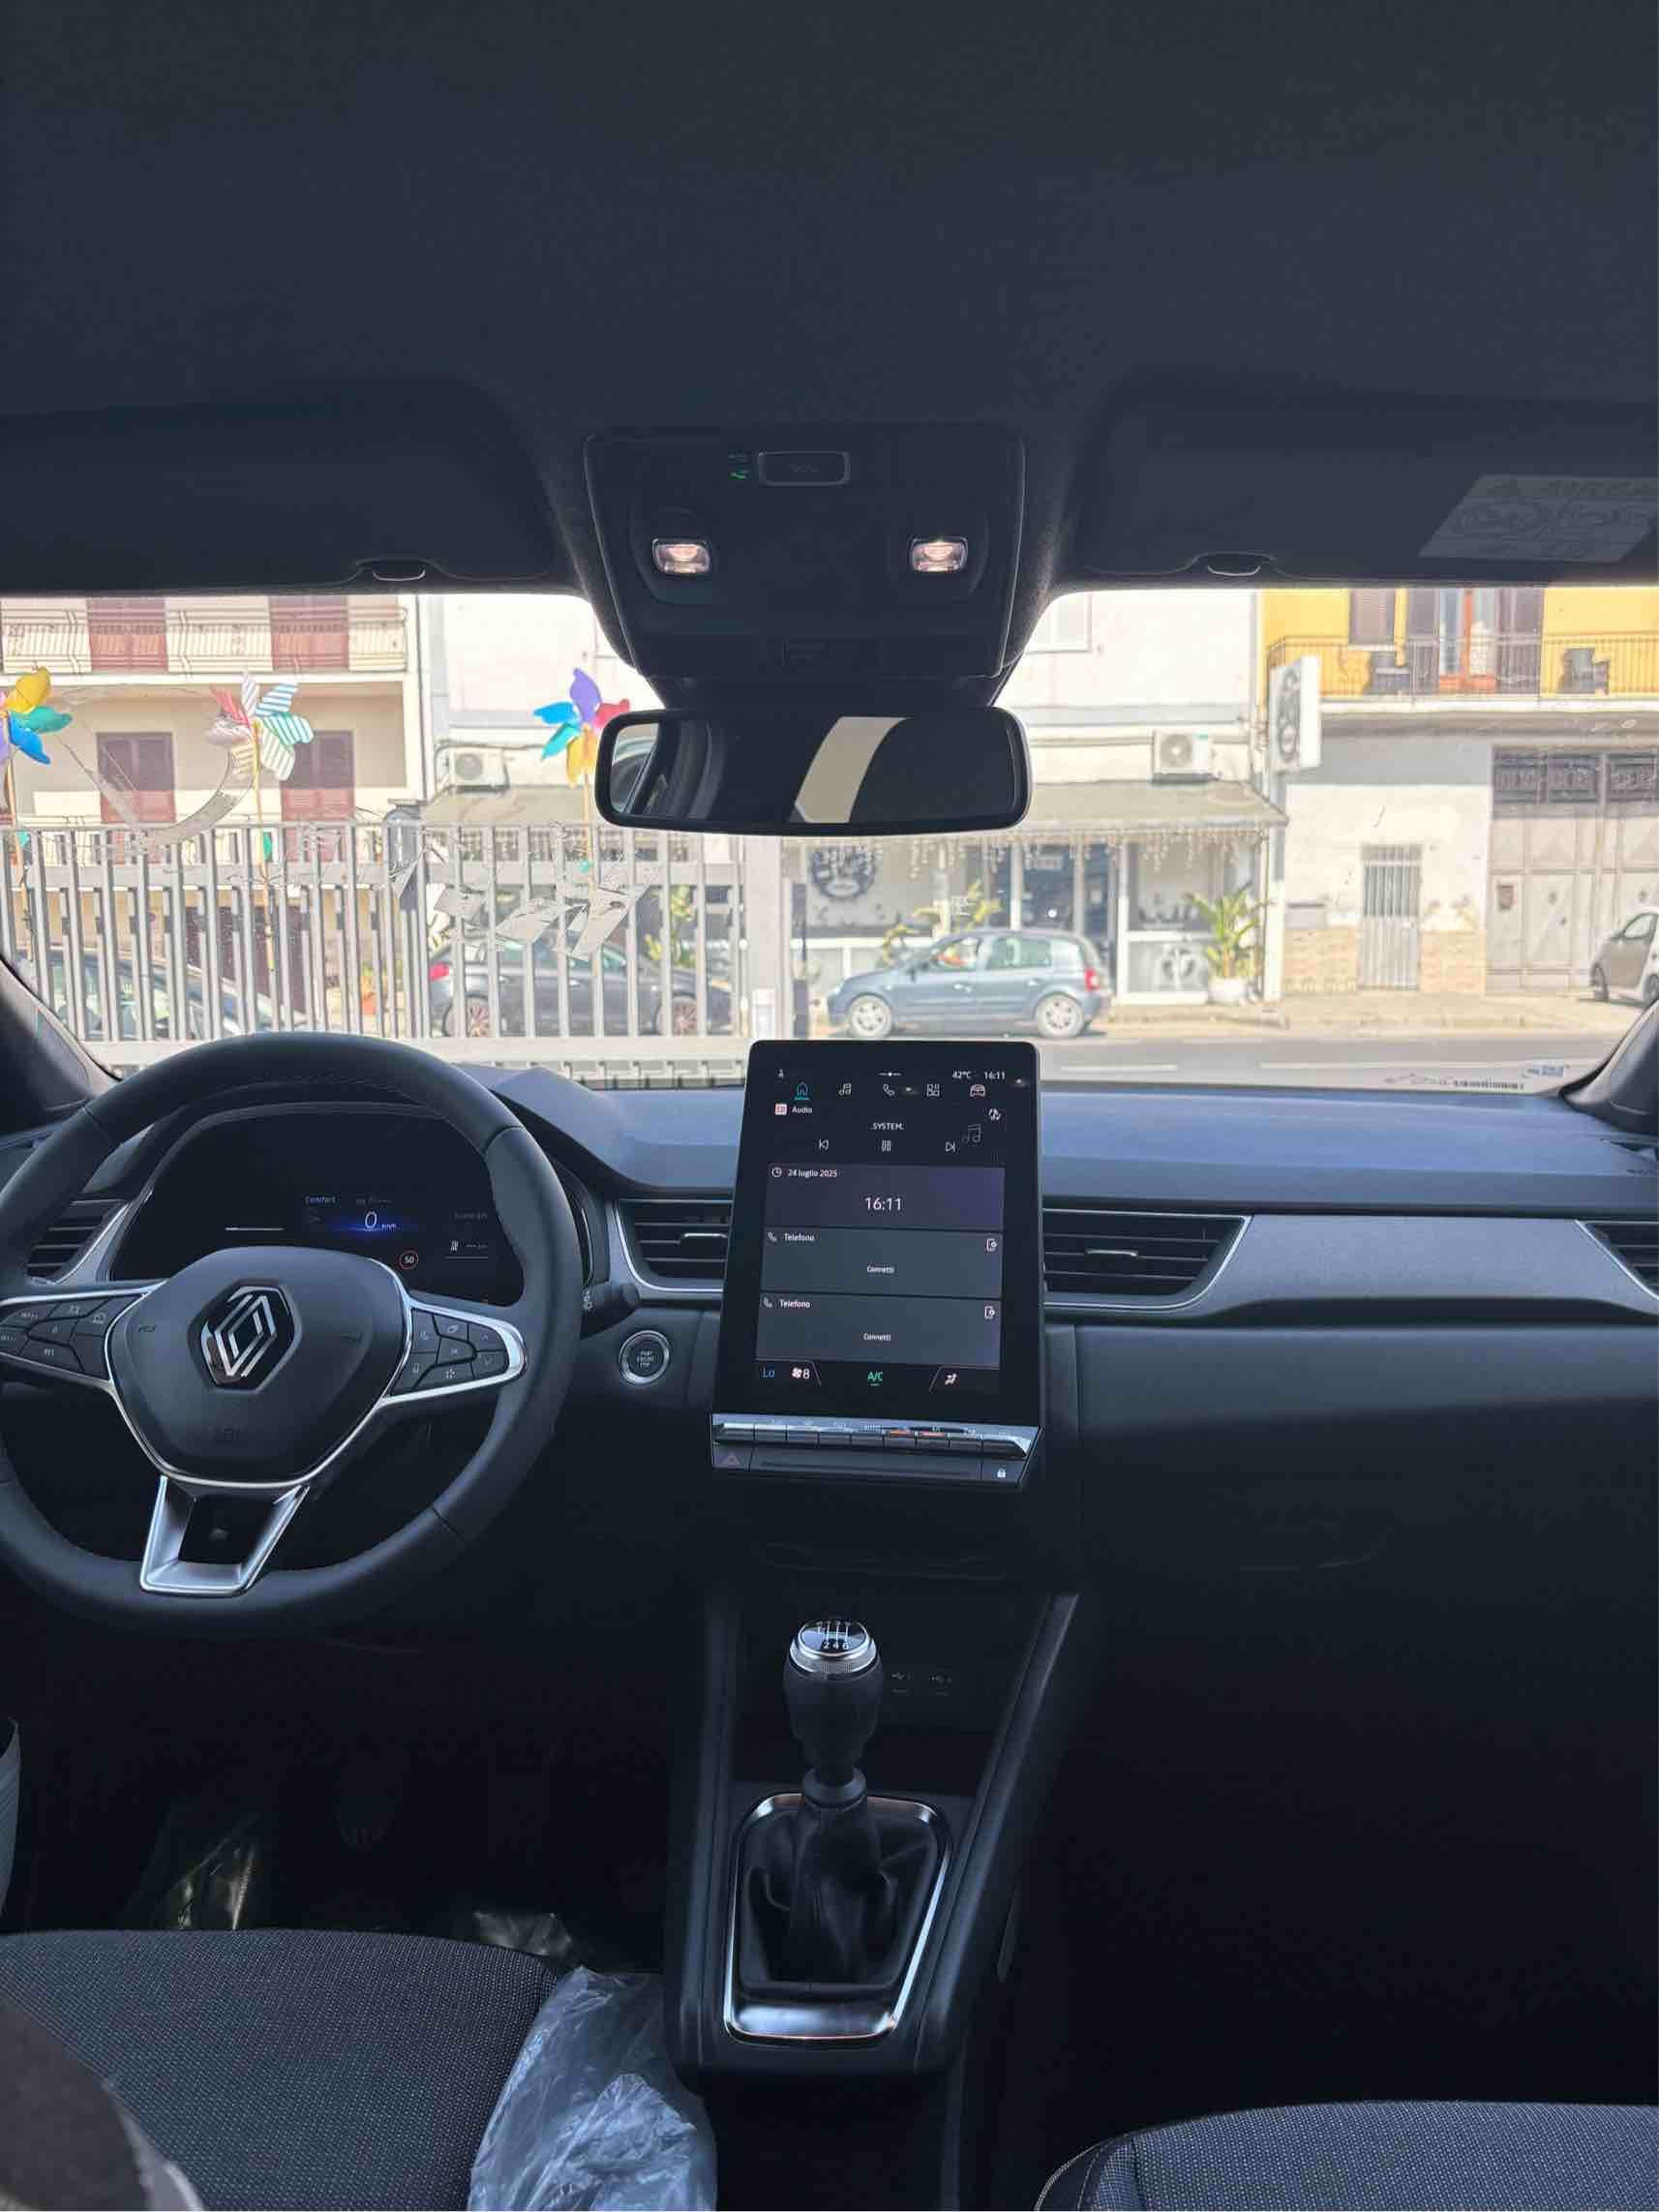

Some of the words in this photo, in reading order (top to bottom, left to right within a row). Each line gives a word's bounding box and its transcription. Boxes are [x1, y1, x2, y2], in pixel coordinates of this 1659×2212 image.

[799, 1168, 818, 1179] luglio
[865, 1197, 902, 1210] 16:11
[365, 1211, 377, 1228] 0
[779, 1299, 810, 1308] Telefono
[867, 1372, 884, 1381] A/C
